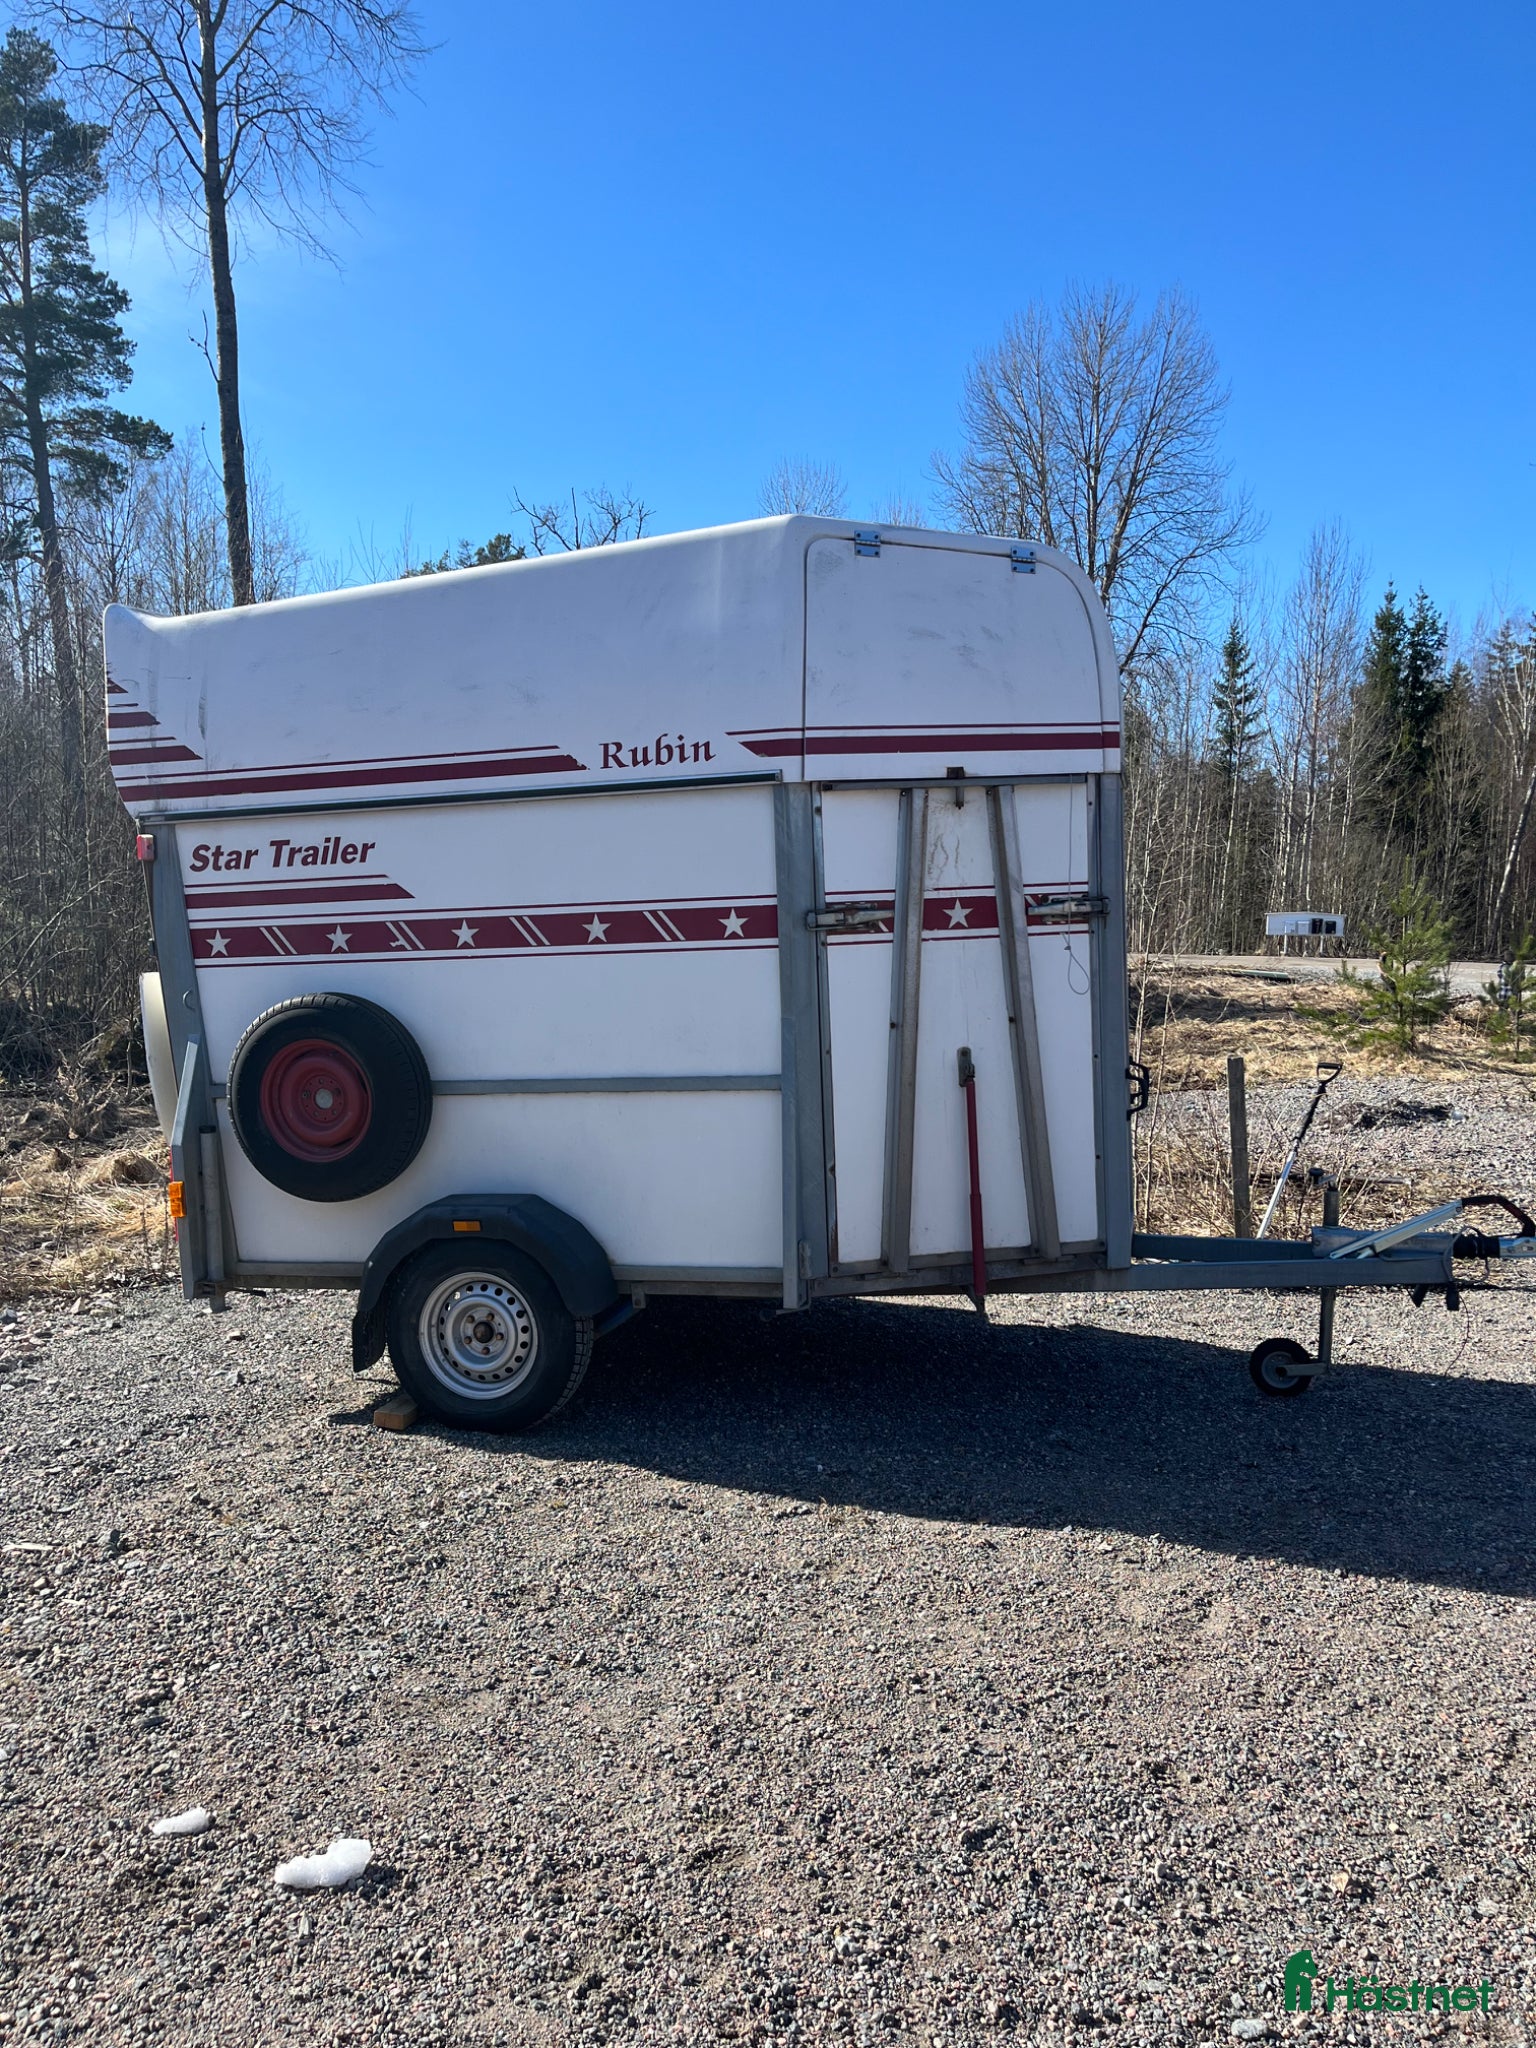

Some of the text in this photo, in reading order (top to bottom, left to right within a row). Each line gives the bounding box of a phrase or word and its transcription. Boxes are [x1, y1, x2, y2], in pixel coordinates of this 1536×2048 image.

[599, 733, 717, 770] Rubin
[190, 836, 376, 872] Star Trailer
